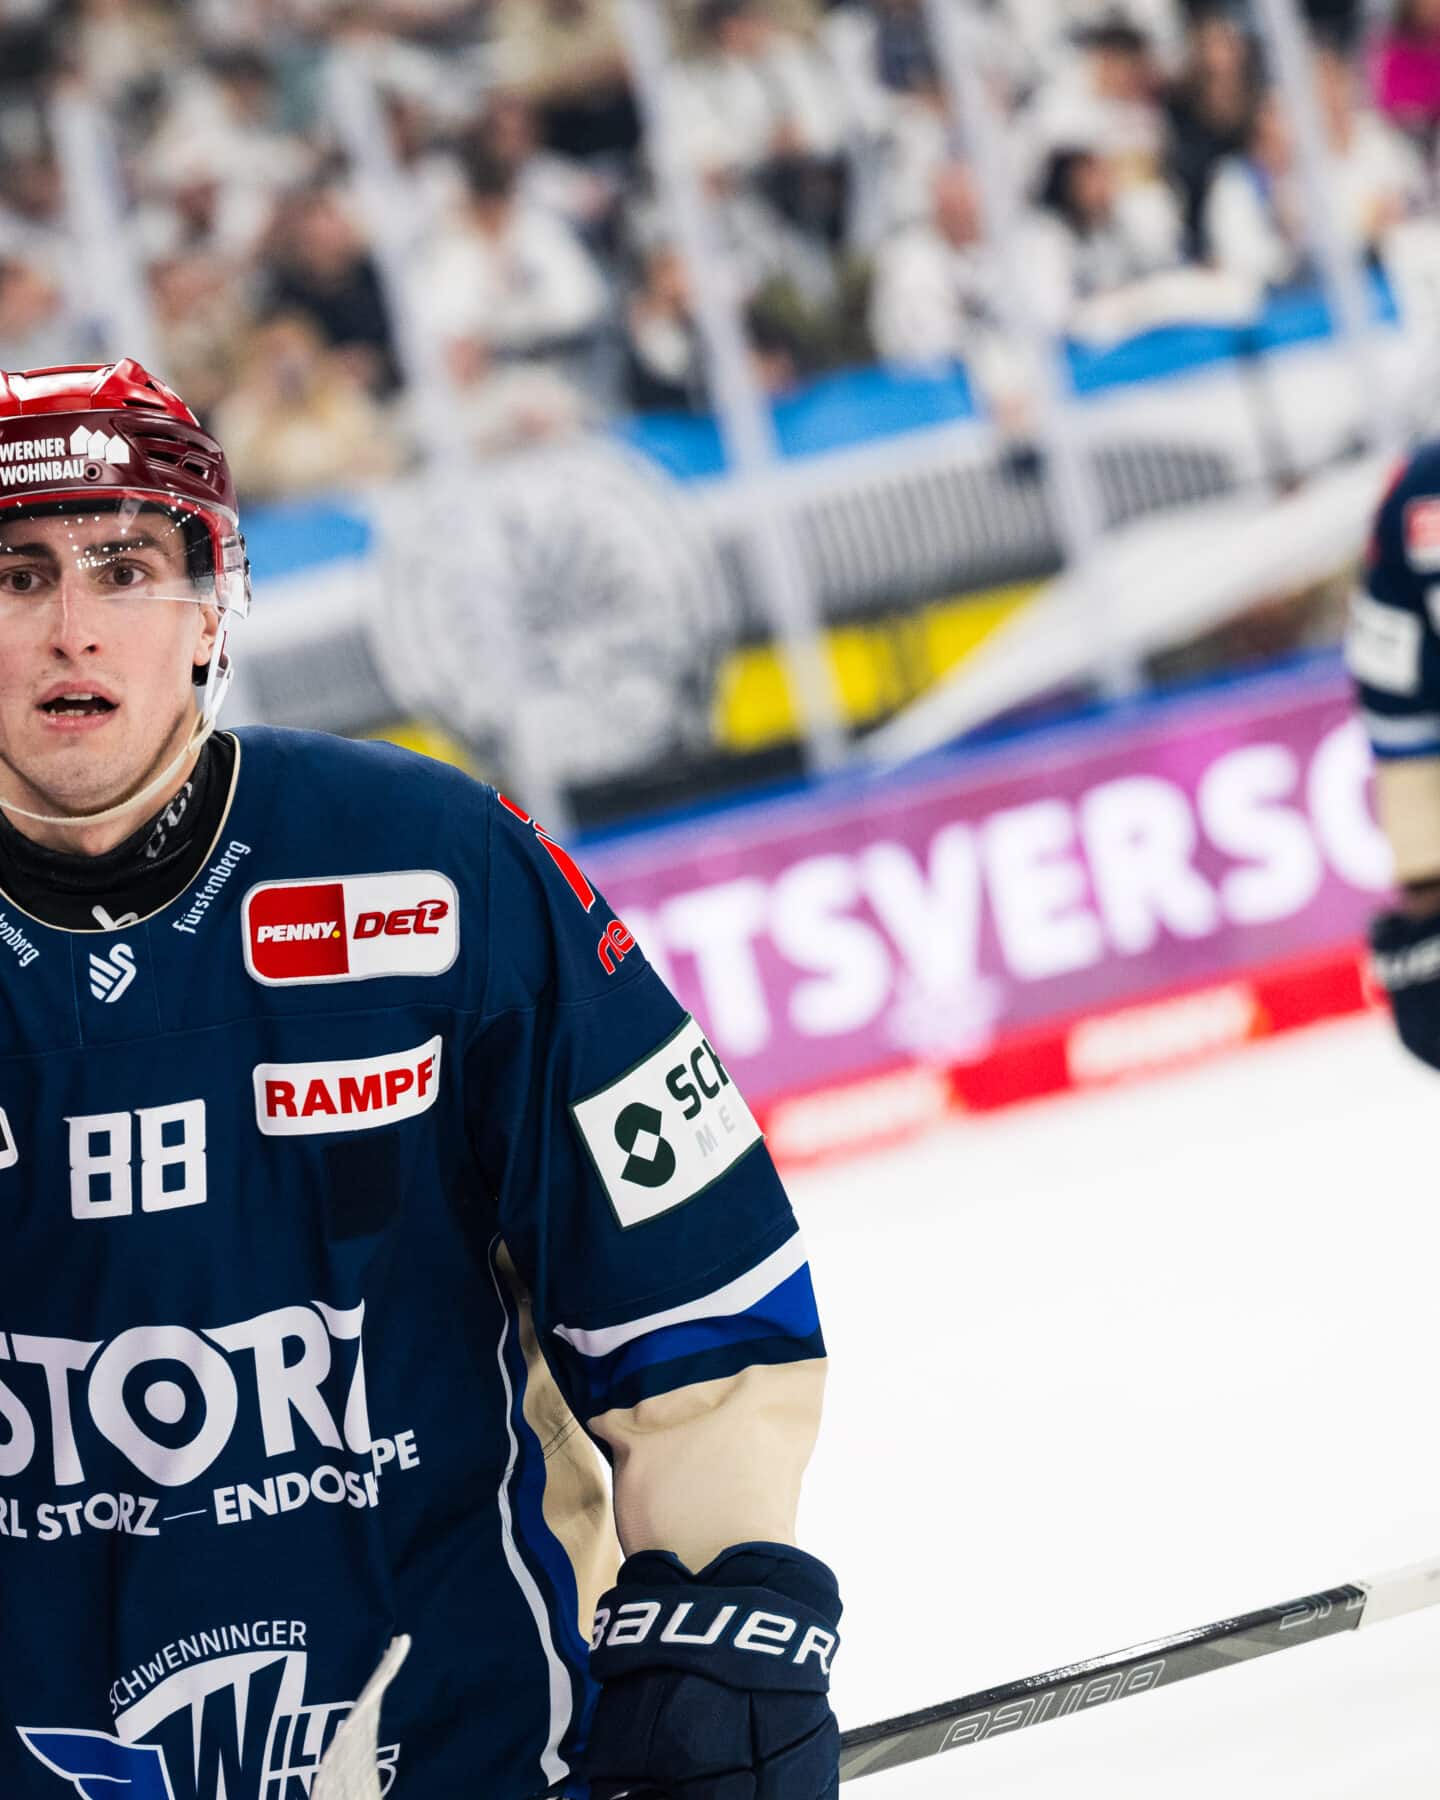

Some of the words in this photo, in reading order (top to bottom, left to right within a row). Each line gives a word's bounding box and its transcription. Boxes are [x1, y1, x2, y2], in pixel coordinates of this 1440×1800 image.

[0, 459, 85, 486] WOHNBAU
[353, 899, 449, 940] DEL
[265, 1056, 433, 1118] RAMPF
[63, 1099, 208, 1220] 88
[37, 1493, 160, 1541] STORZ
[109, 1620, 307, 1715] SCHWENNINGER
